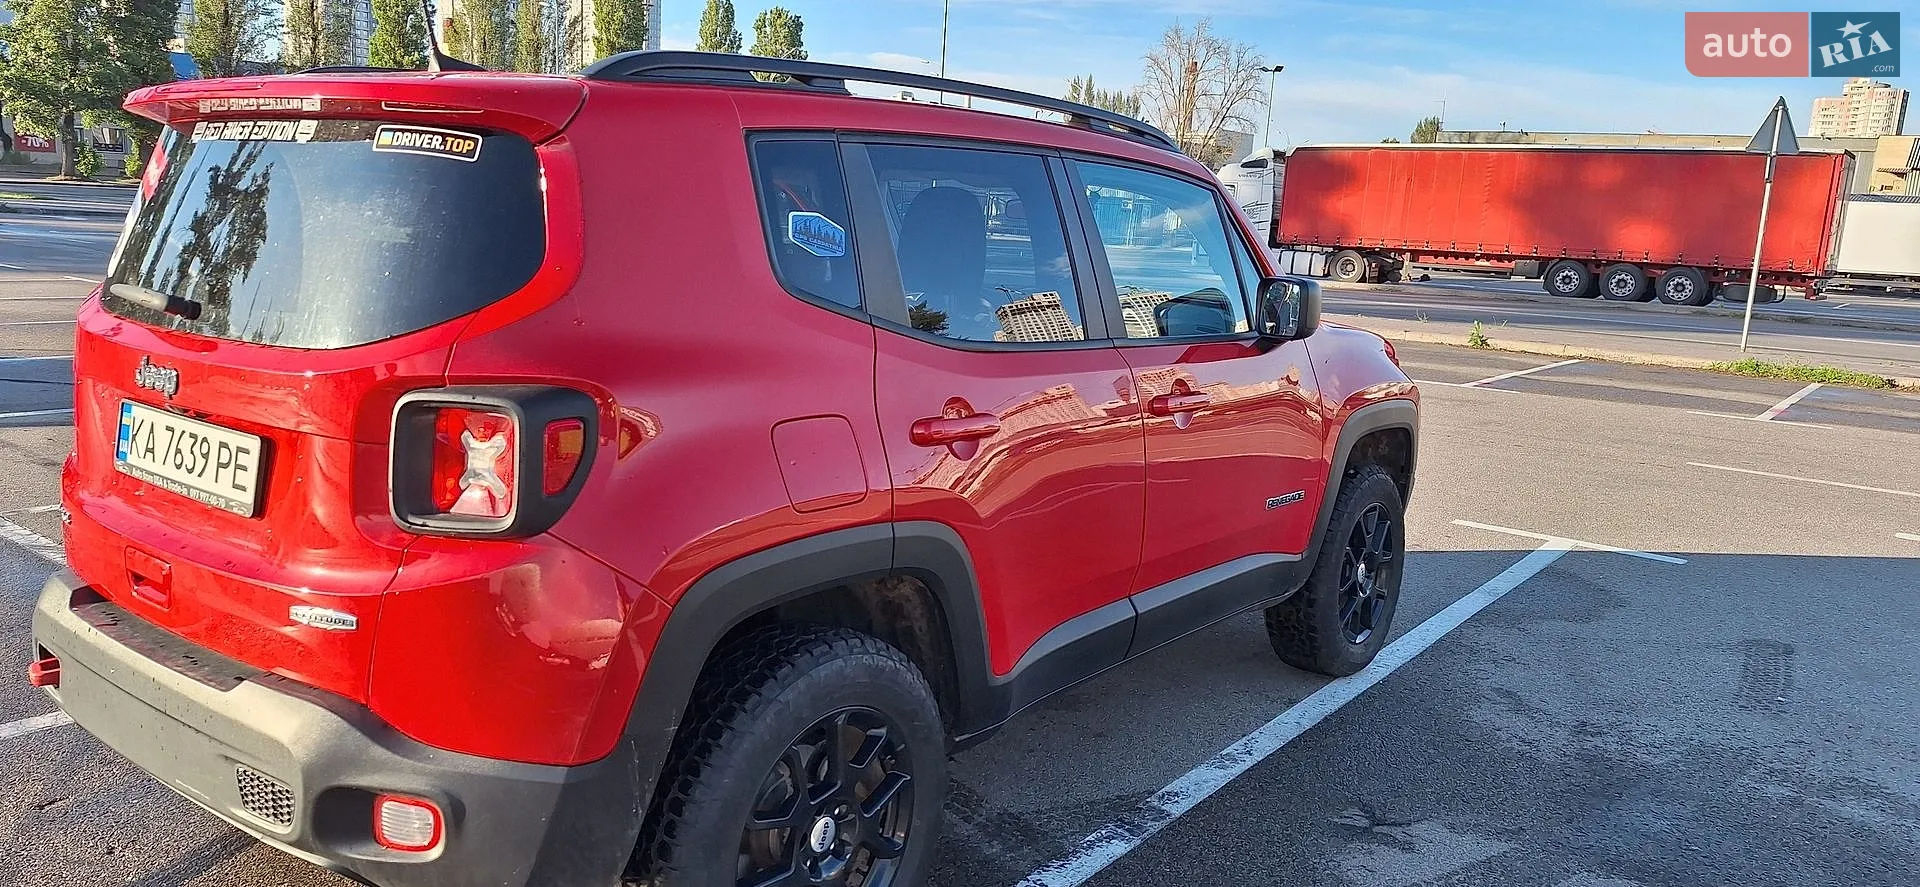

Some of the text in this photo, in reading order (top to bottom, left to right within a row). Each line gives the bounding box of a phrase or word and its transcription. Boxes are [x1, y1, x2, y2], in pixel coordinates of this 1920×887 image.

[21, 135, 50, 148] -70%
[202, 120, 299, 141] RED RIVER EDITION
[391, 131, 475, 154] DRIVER.TOP
[130, 416, 250, 492] KA 7639 PE
